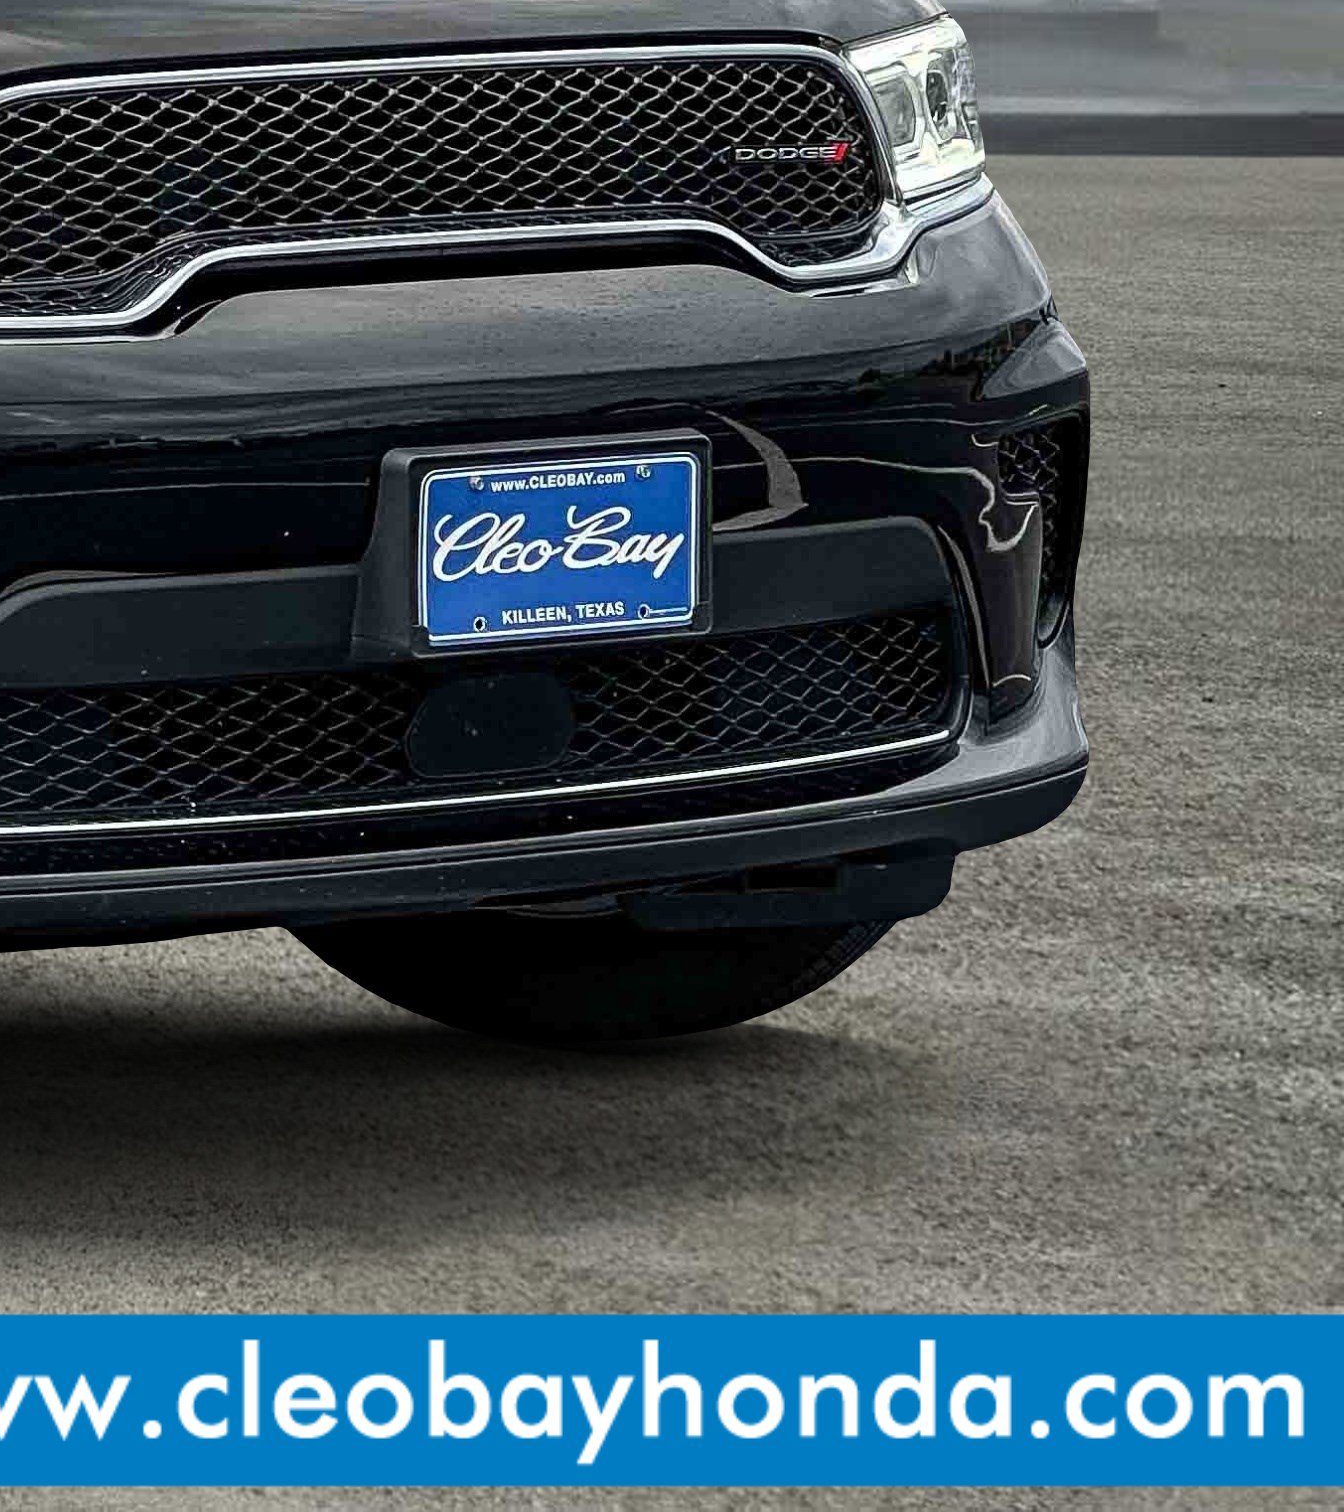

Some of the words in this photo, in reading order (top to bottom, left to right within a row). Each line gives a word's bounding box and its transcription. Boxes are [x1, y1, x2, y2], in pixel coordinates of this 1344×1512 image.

[734, 145, 838, 161] DODGE
[490, 470, 626, 493] www.CLEOBAY.com
[432, 511, 563, 582] Cleo
[561, 505, 685, 579] Bay
[502, 604, 572, 625] KILLEEN,
[576, 601, 625, 620] TEXAS
